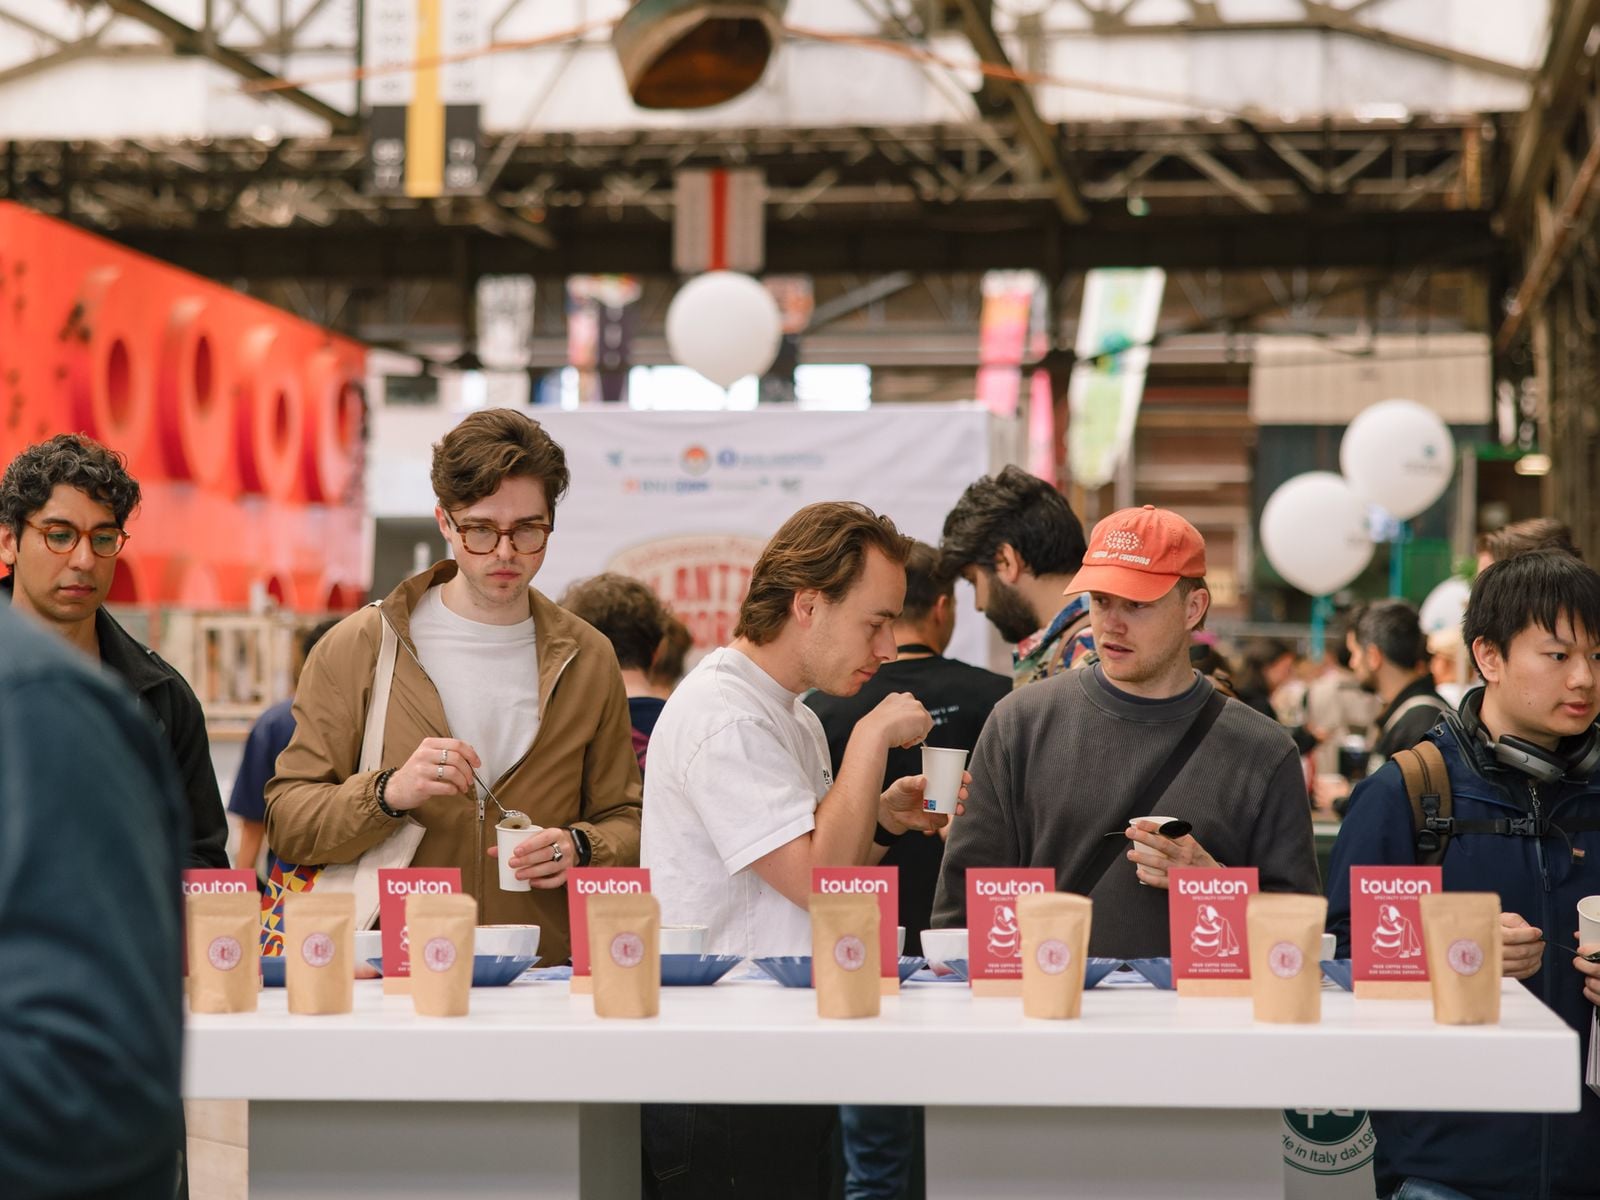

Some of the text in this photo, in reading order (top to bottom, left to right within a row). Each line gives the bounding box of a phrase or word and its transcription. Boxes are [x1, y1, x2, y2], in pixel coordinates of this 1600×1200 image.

[182, 880, 247, 895] touton
[387, 879, 452, 894] touton
[577, 879, 641, 894] touton
[821, 878, 888, 893] touton
[976, 880, 1044, 895] touton
[1179, 878, 1248, 894] touton
[1361, 878, 1431, 894] touton
[1295, 1143, 1307, 1159] in
[1309, 1150, 1337, 1166] Italy
[1340, 1143, 1361, 1161] dal
